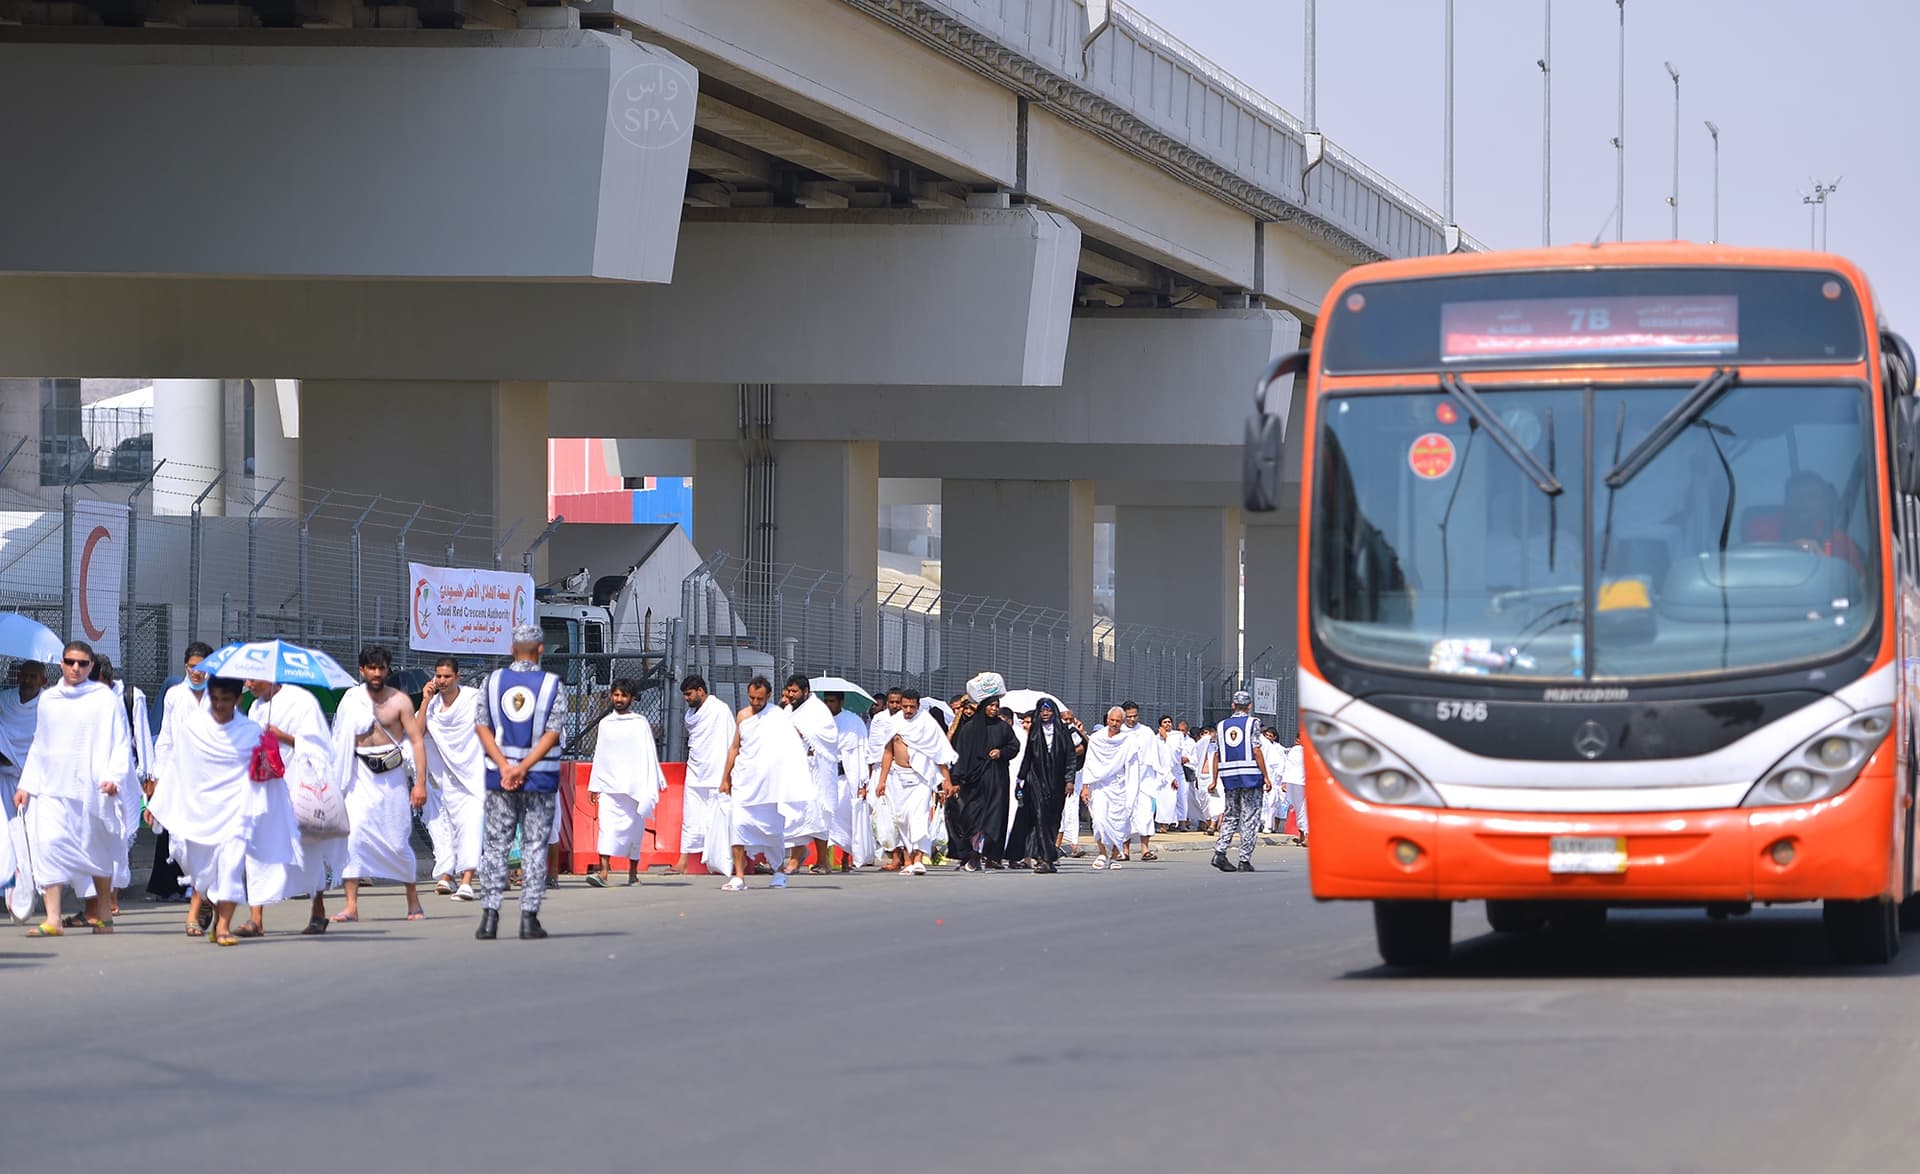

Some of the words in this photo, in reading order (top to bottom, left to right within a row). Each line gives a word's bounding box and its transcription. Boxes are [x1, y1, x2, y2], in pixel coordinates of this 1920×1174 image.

[1567, 308, 1611, 332] 7B
[436, 604, 452, 617] Saudi
[452, 606, 464, 617] Red
[464, 606, 487, 619] Crescent
[487, 608, 511, 622] Authority
[284, 668, 315, 679] mobily
[1436, 701, 1488, 721] 5786
